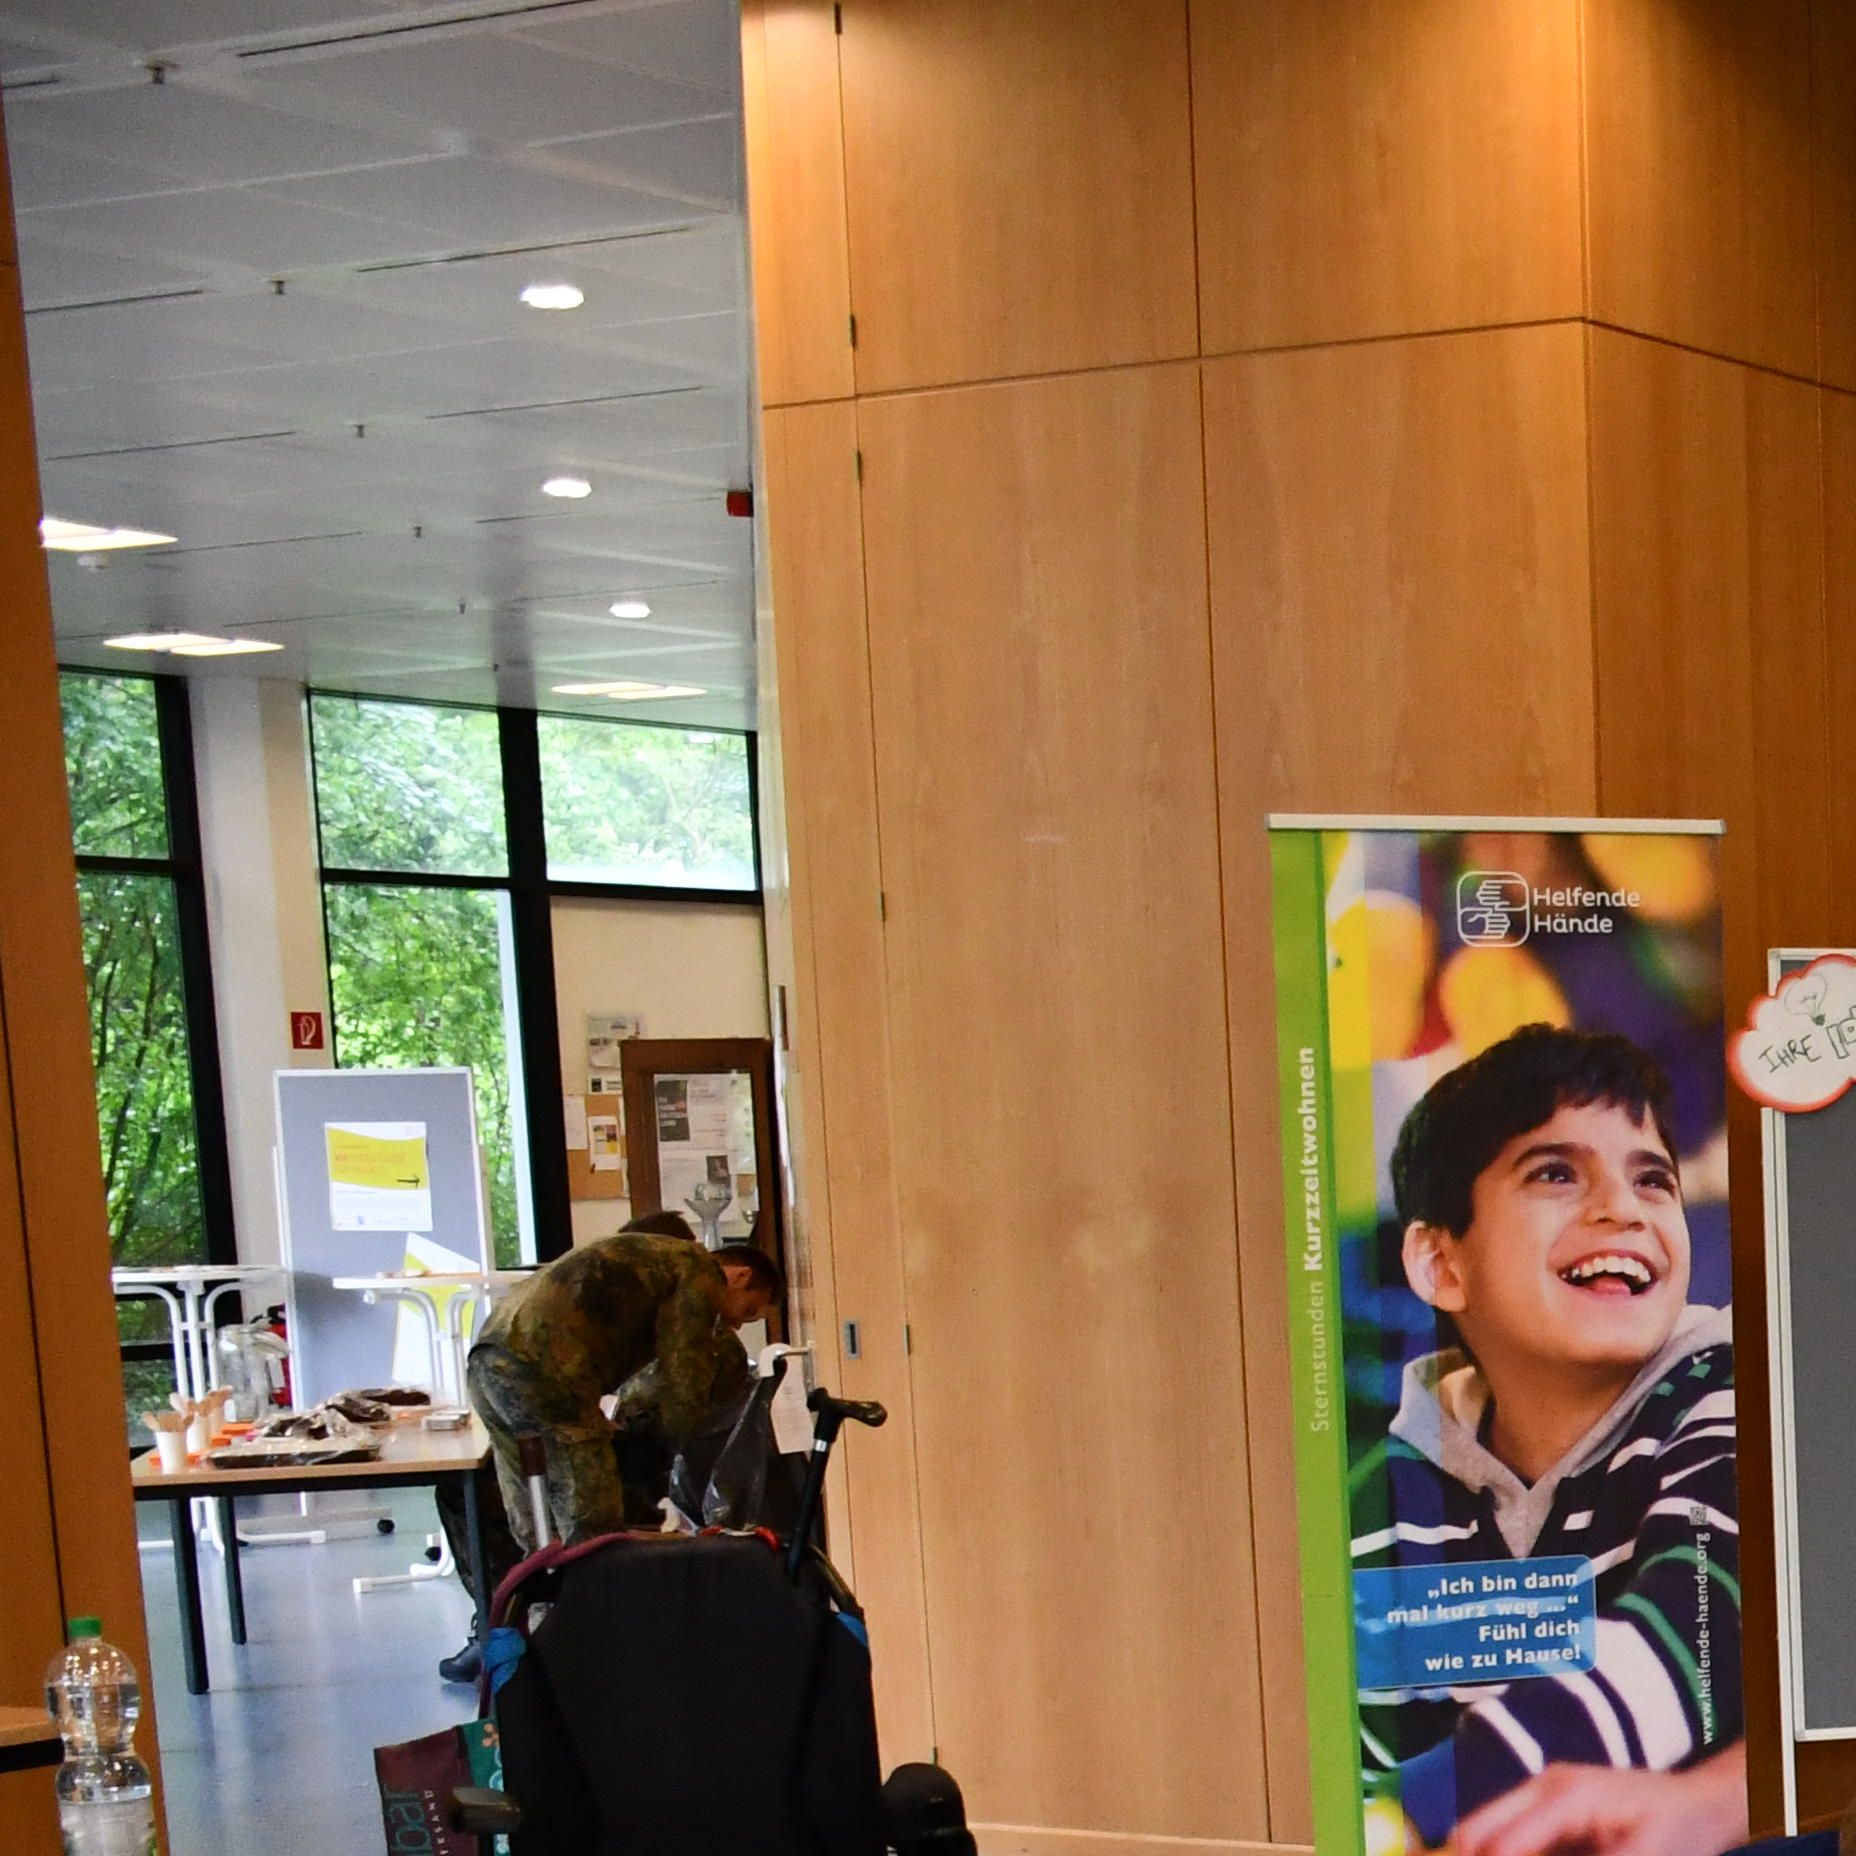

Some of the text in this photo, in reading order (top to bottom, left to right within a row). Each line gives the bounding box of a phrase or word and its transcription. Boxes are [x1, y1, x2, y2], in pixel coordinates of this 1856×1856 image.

[1533, 887, 1641, 908] Helfende
[1534, 913, 1613, 934] Hände
[1758, 1033, 1822, 1074] IHRE
[1298, 1047, 1330, 1432] Sternstunden Kurzzeitwohnen
[1482, 1574, 1517, 1592] bin
[1524, 1572, 1579, 1589] dann
[1387, 1604, 1428, 1624] mal
[1437, 1603, 1488, 1620] kurz
[1496, 1600, 1539, 1619] weg
[1479, 1621, 1580, 1642] Fühl dich
[1694, 1531, 1713, 1745] www.helfende-haende.org
[1425, 1645, 1581, 1671] wie zu Hause!
